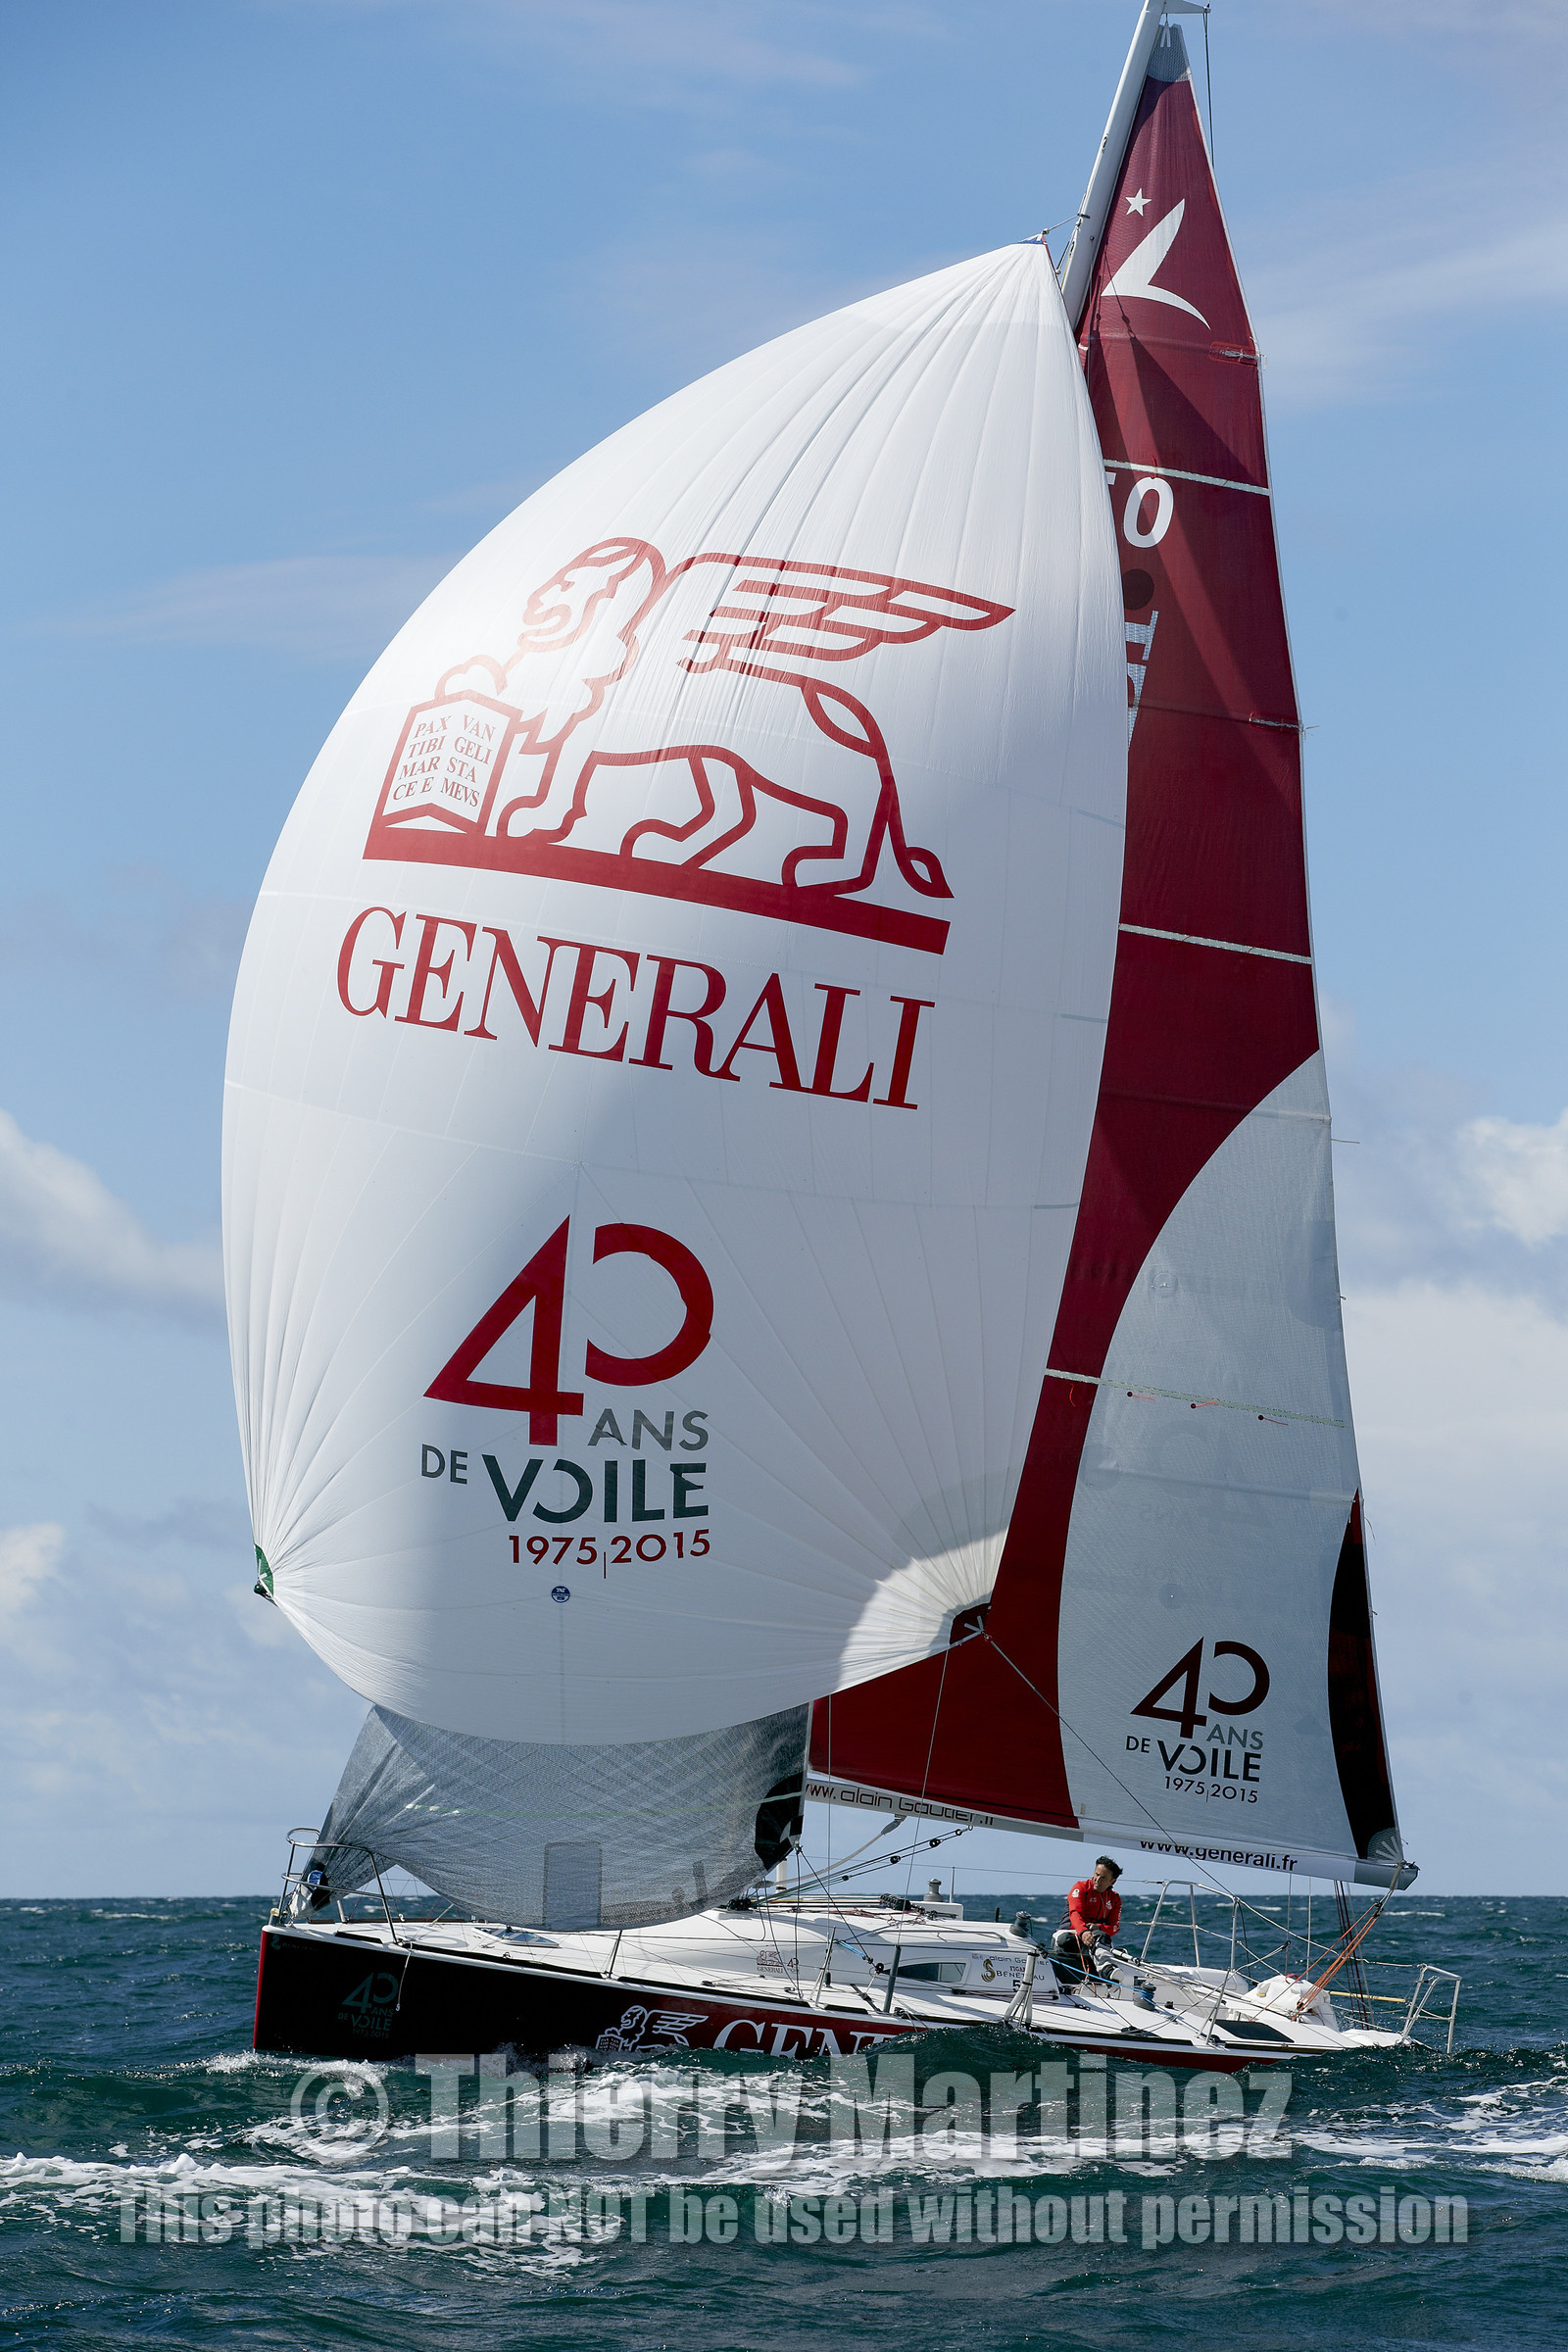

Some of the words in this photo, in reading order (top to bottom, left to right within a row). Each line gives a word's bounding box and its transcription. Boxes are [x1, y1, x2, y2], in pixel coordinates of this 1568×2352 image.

[412, 715, 453, 739] PAX
[464, 714, 496, 742] VAN
[408, 735, 447, 759] TIBI
[454, 736, 493, 764] GELI
[398, 756, 440, 780] MAR
[447, 757, 476, 783] STA
[392, 781, 417, 800] CE
[420, 776, 434, 794] E
[337, 906, 935, 1110] GENERALI
[588, 1408, 709, 1450] ANS
[421, 1444, 467, 1485] DE
[481, 1454, 709, 1524] VOILE
[1206, 1724, 1263, 1750] ANS
[1126, 1736, 1151, 1753] DE
[1157, 1740, 1262, 1783] VOILE
[840, 1788, 893, 1808] alain
[1140, 1840, 1298, 1871] www.generali.fr
[370, 2007, 394, 2017] ANS
